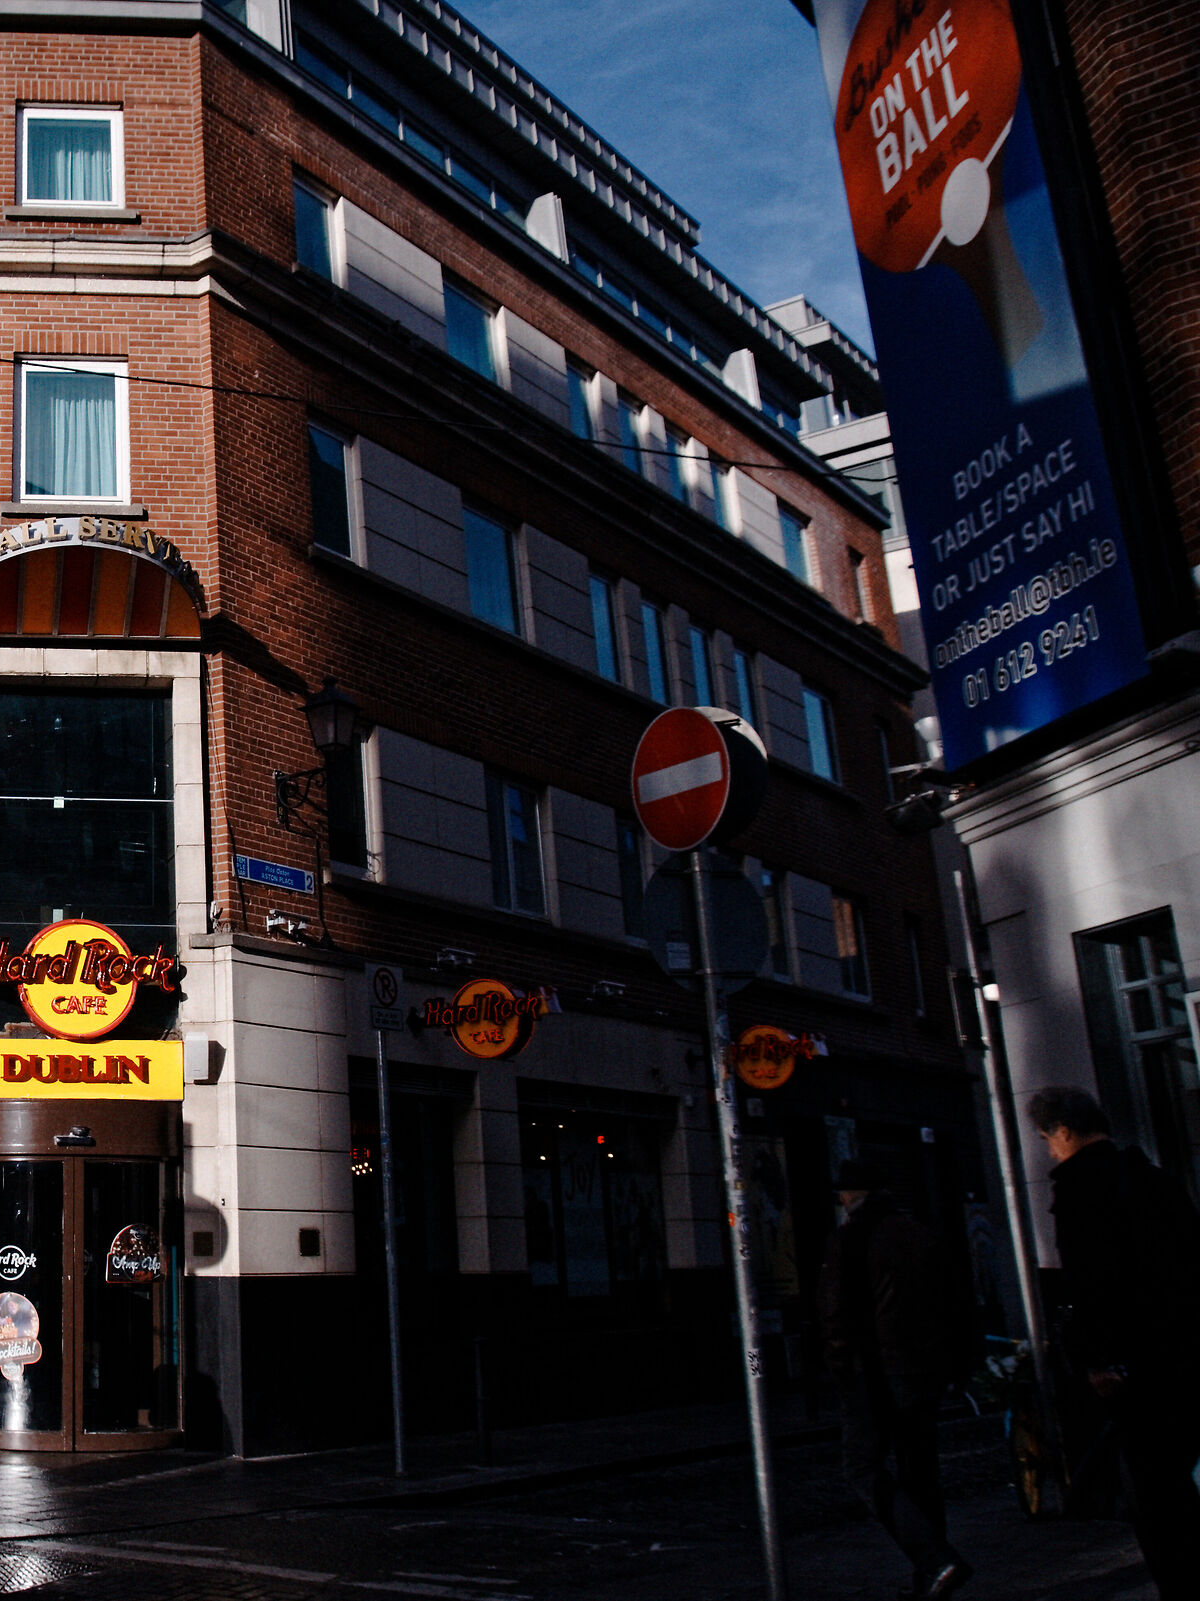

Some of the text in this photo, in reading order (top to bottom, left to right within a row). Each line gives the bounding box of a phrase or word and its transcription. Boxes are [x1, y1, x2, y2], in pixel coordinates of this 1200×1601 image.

[870, 9, 958, 138] ON THE
[874, 62, 970, 195] BALL
[952, 421, 1034, 500] BOOK A
[931, 438, 1078, 562] TABLE/SPACE
[932, 481, 1098, 612] OR JUST SAY HI
[932, 537, 1119, 669] ontheball@tbh.ie
[961, 604, 1100, 709] 01 612 9241
[261, 872, 294, 886] ASTON PLACE
[306, 874, 313, 891] 2
[81, 938, 176, 994] Rock
[51, 995, 108, 1016] CAFE
[424, 997, 480, 1027] Hard
[481, 991, 541, 1026] Rock
[0, 1054, 152, 1085] DUBLIN
[764, 1032, 814, 1065] Rock
[10, 1252, 37, 1268] Rock
